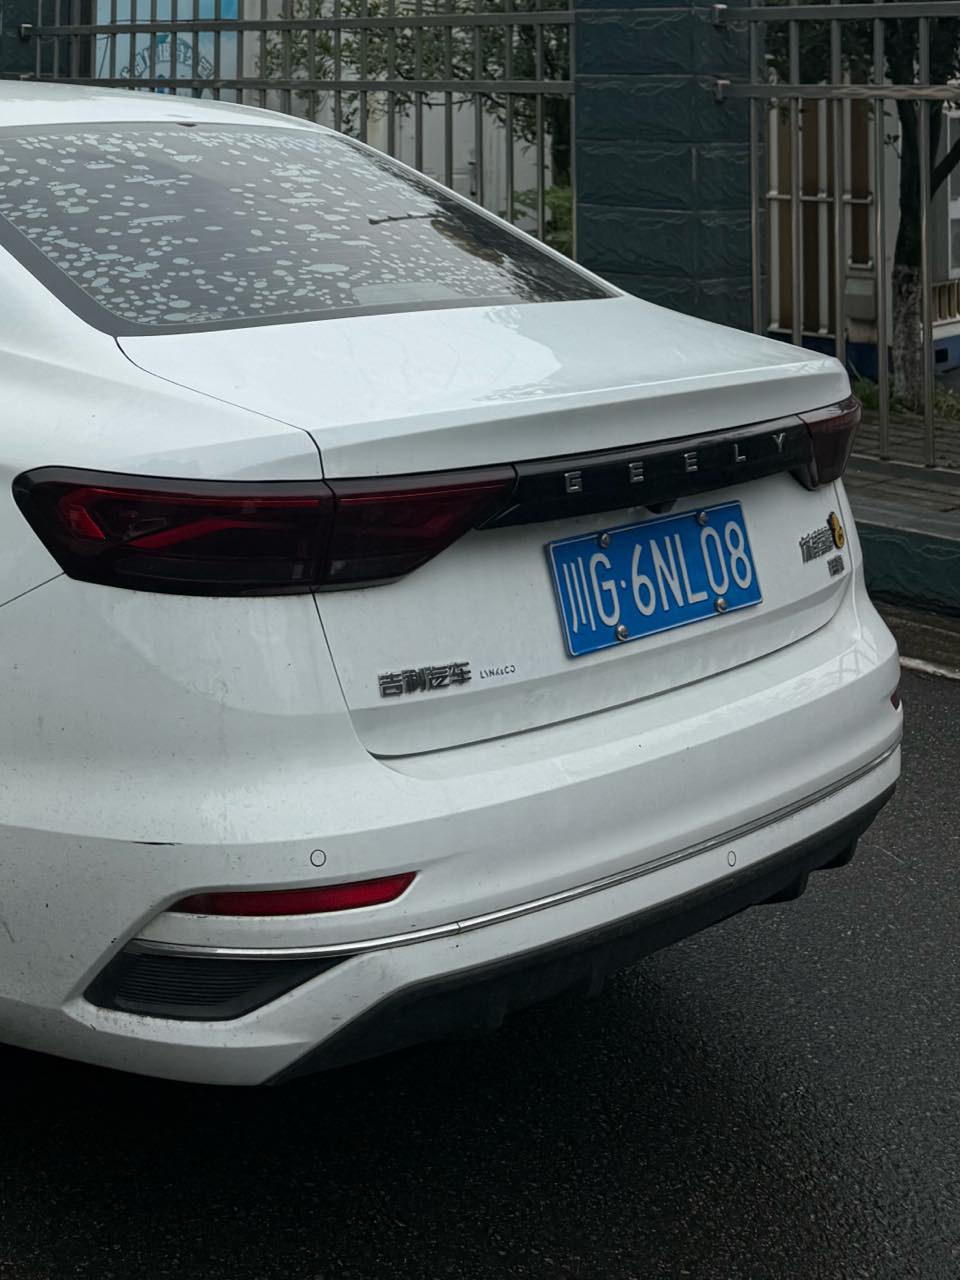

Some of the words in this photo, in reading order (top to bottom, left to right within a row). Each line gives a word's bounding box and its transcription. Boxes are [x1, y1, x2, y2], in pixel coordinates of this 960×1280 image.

[564, 432, 787, 494] GEELY
[378, 661, 472, 698] 吉利汽车
